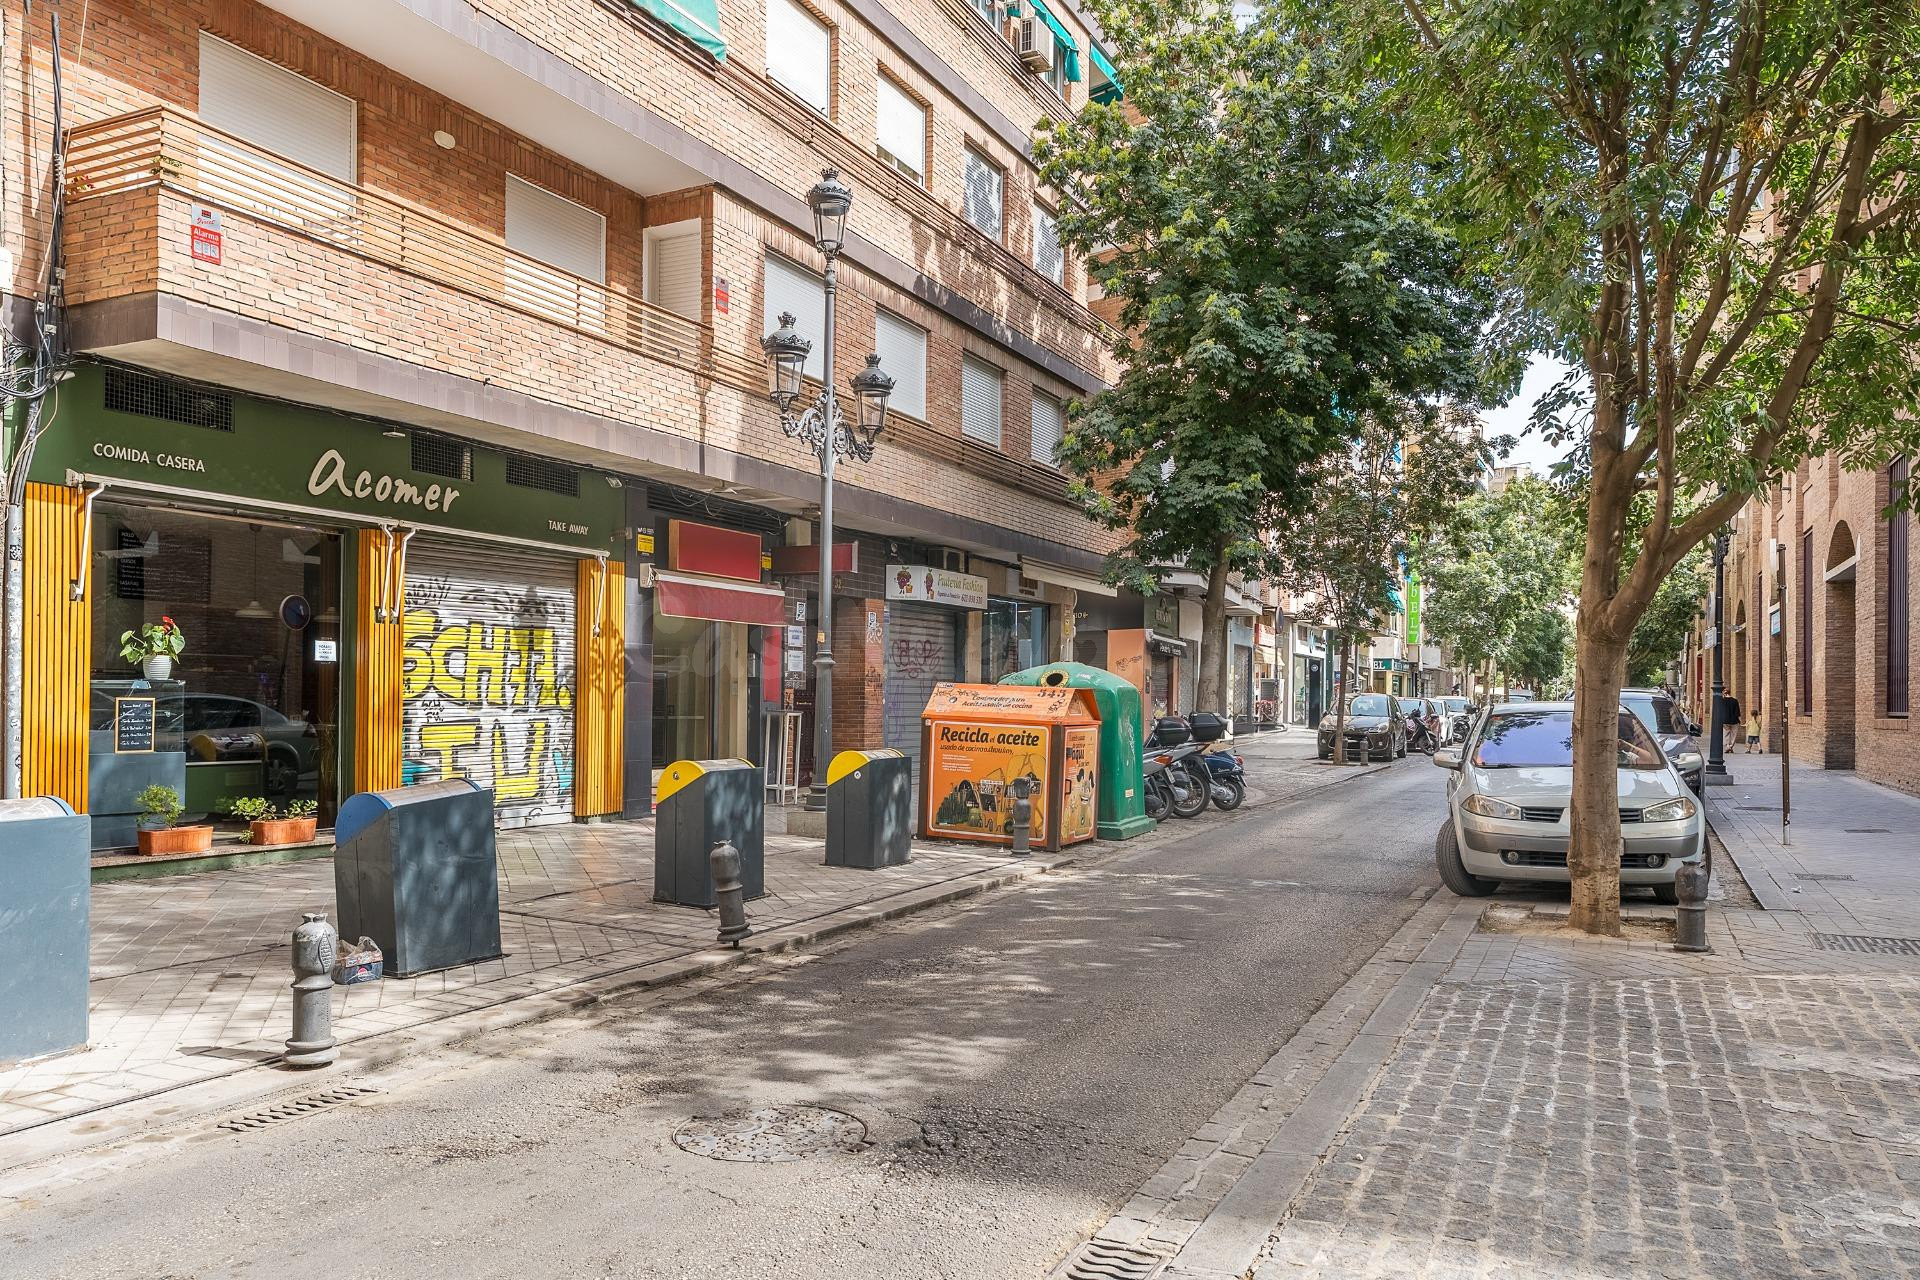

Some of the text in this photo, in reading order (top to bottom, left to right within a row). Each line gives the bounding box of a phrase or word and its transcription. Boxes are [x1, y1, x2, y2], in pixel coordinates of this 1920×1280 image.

[193, 228, 220, 241] Alarma
[93, 443, 206, 473] COMIDA CASERA
[548, 520, 589, 535] TAKE AWAY
[940, 726, 990, 744] Recicla
[996, 730, 1040, 747] aceite
